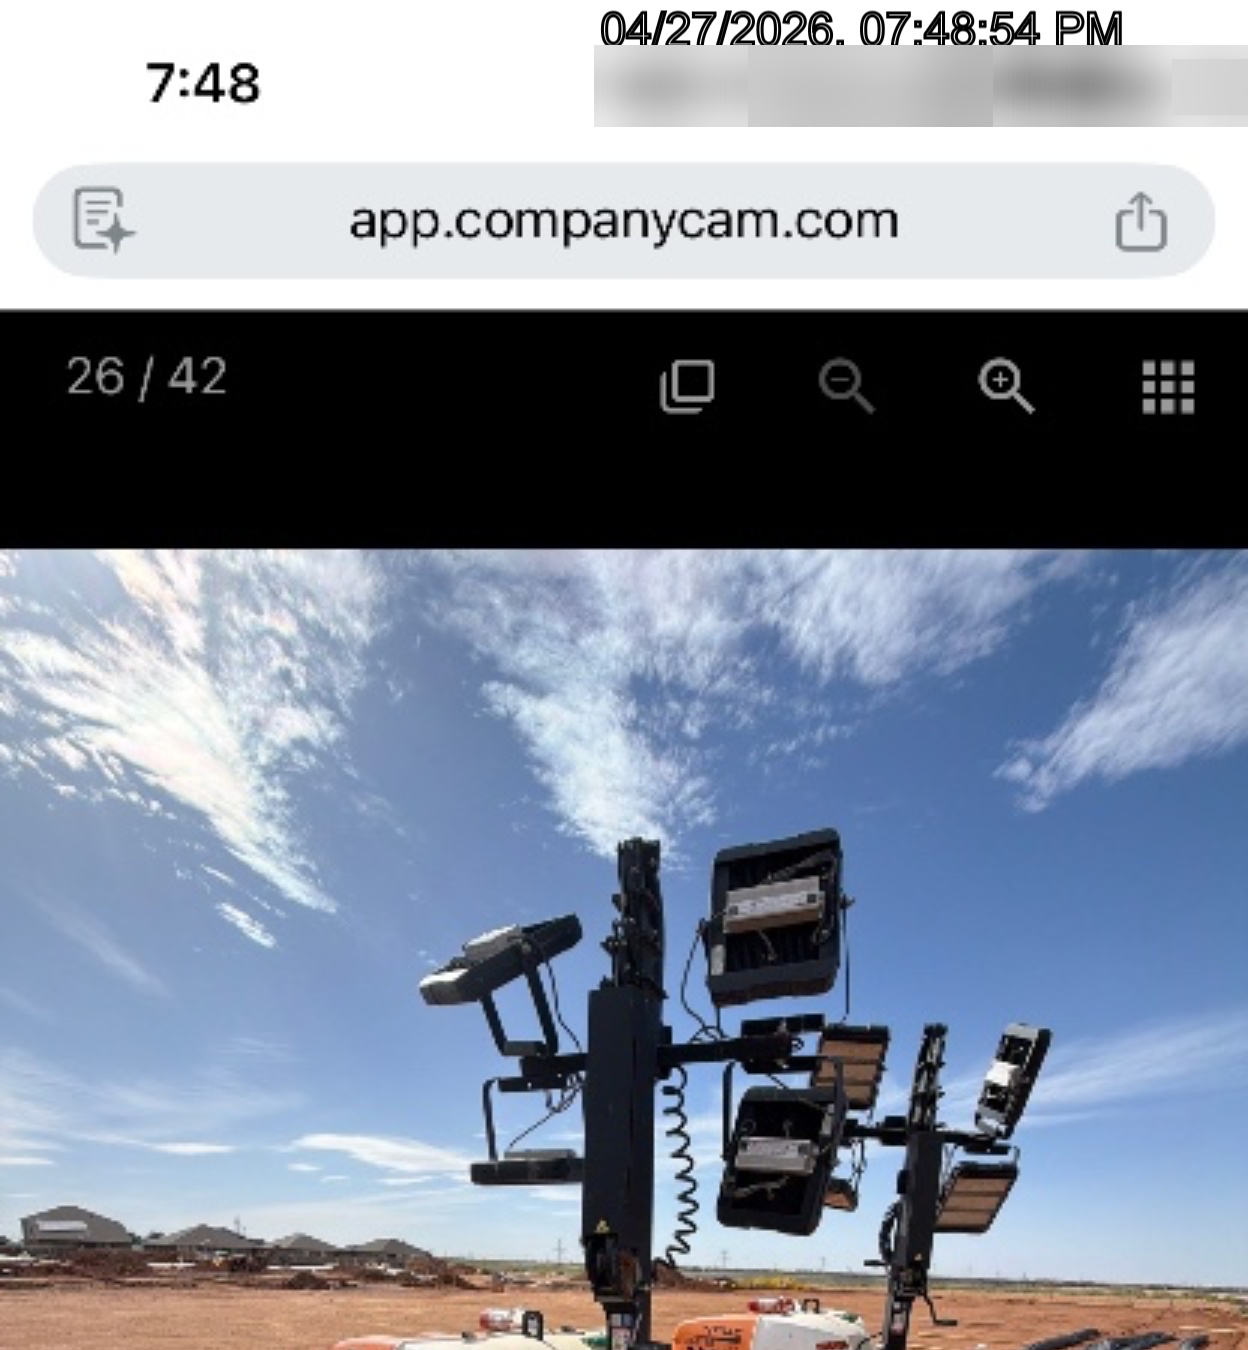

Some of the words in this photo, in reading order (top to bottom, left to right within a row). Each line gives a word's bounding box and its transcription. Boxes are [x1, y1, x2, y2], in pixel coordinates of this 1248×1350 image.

[146, 62, 260, 103] 7:48
[350, 206, 898, 249] app.companycam.com
[67, 355, 124, 395] 26
[168, 355, 227, 395] 42
